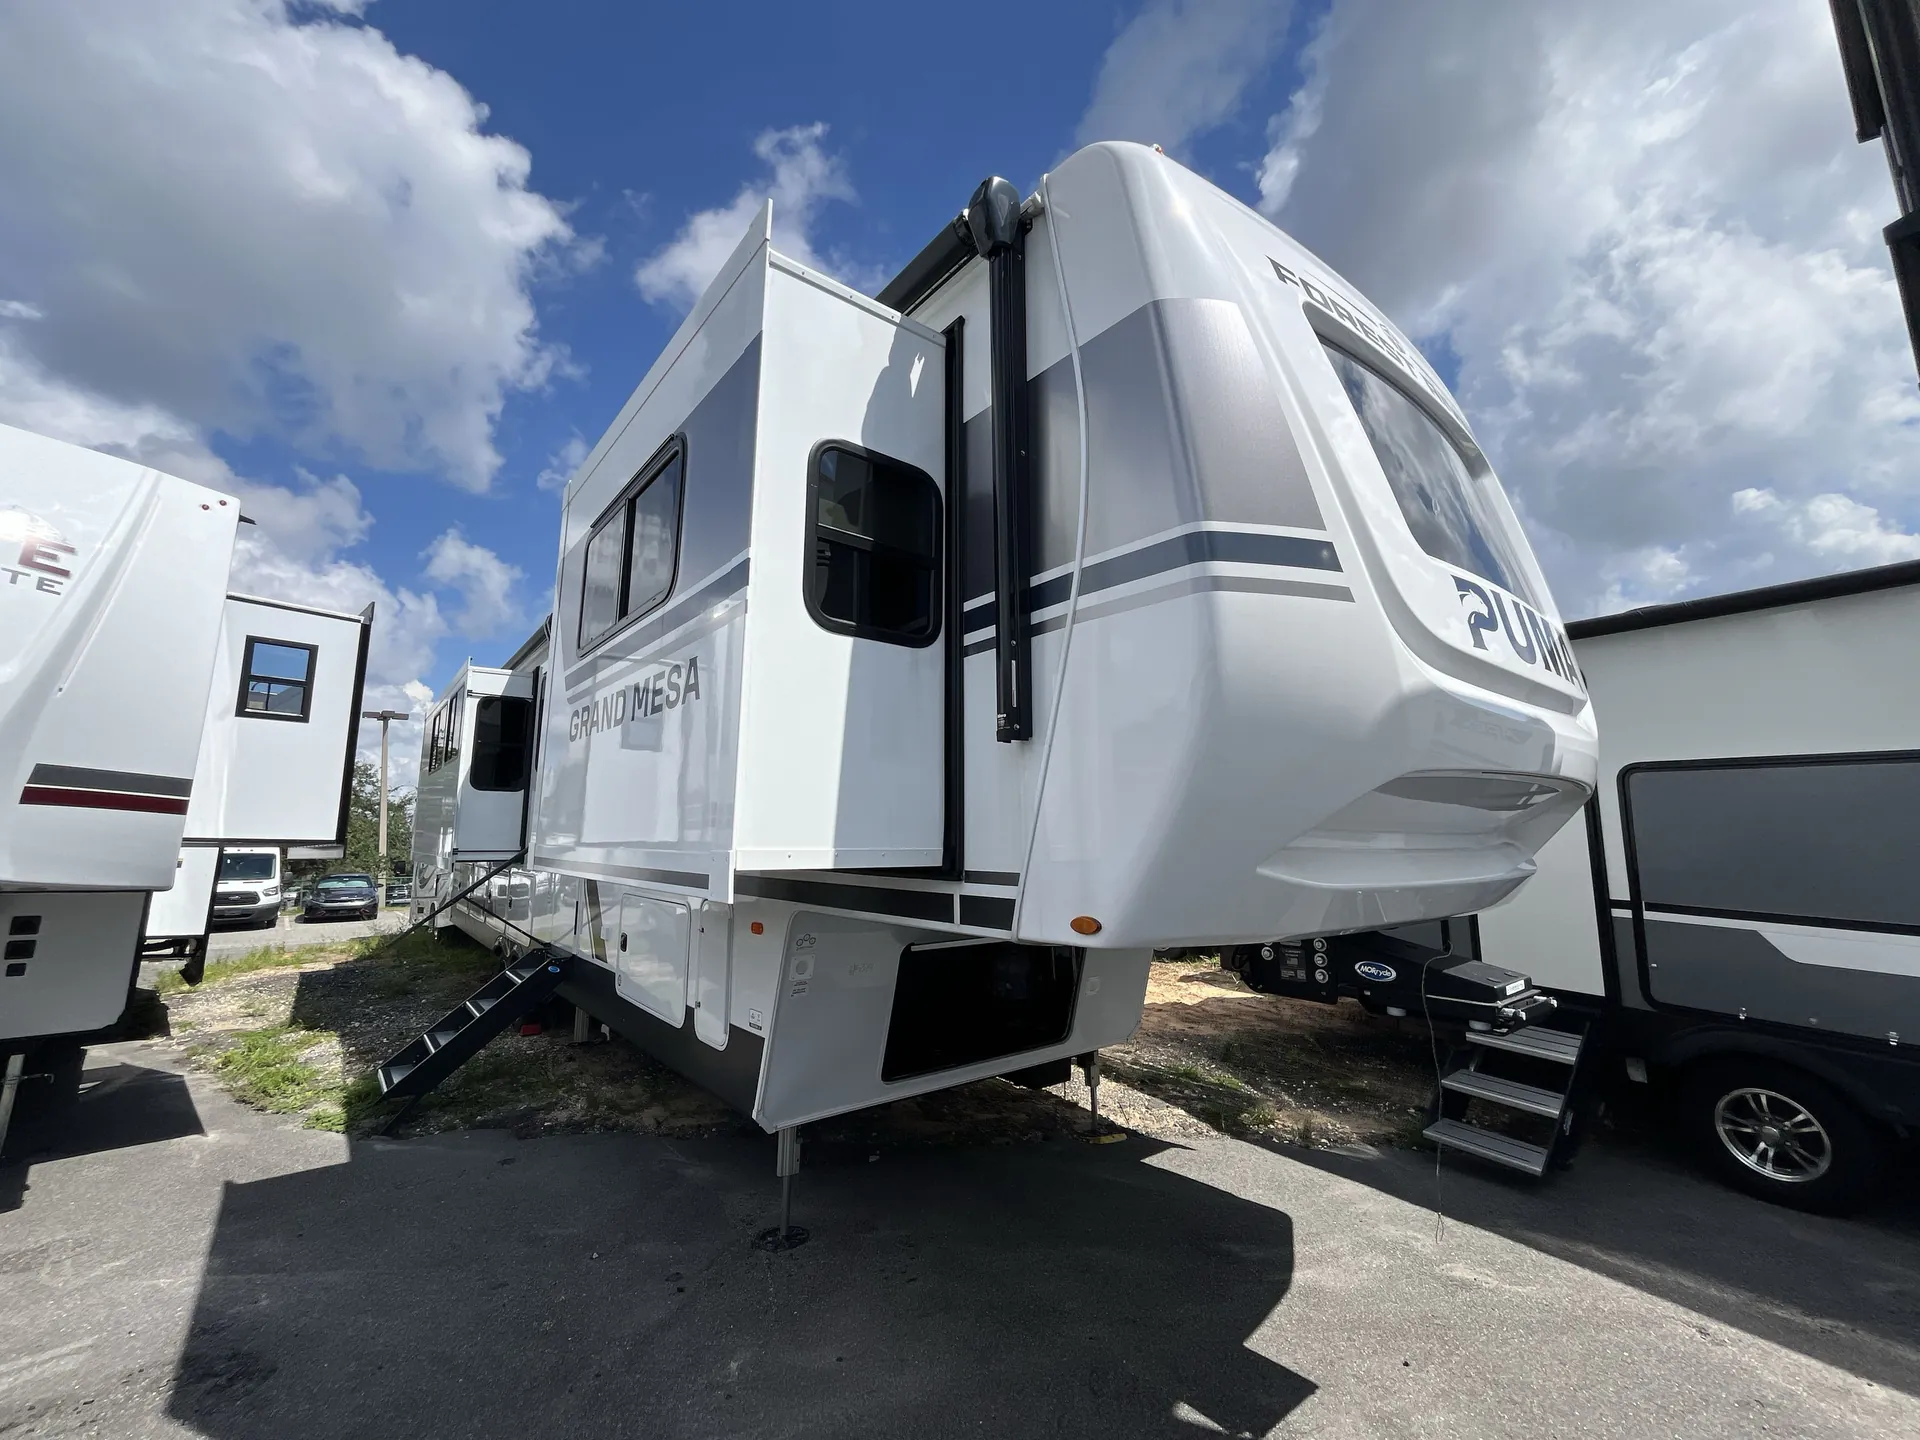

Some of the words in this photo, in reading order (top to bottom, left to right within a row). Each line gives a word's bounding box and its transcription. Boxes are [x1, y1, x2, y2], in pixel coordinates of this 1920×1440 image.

[1265, 254, 1417, 379] FOREST
[1450, 574, 1584, 693] PUMA
[569, 689, 626, 742] GRAND
[631, 656, 700, 721] MESA
